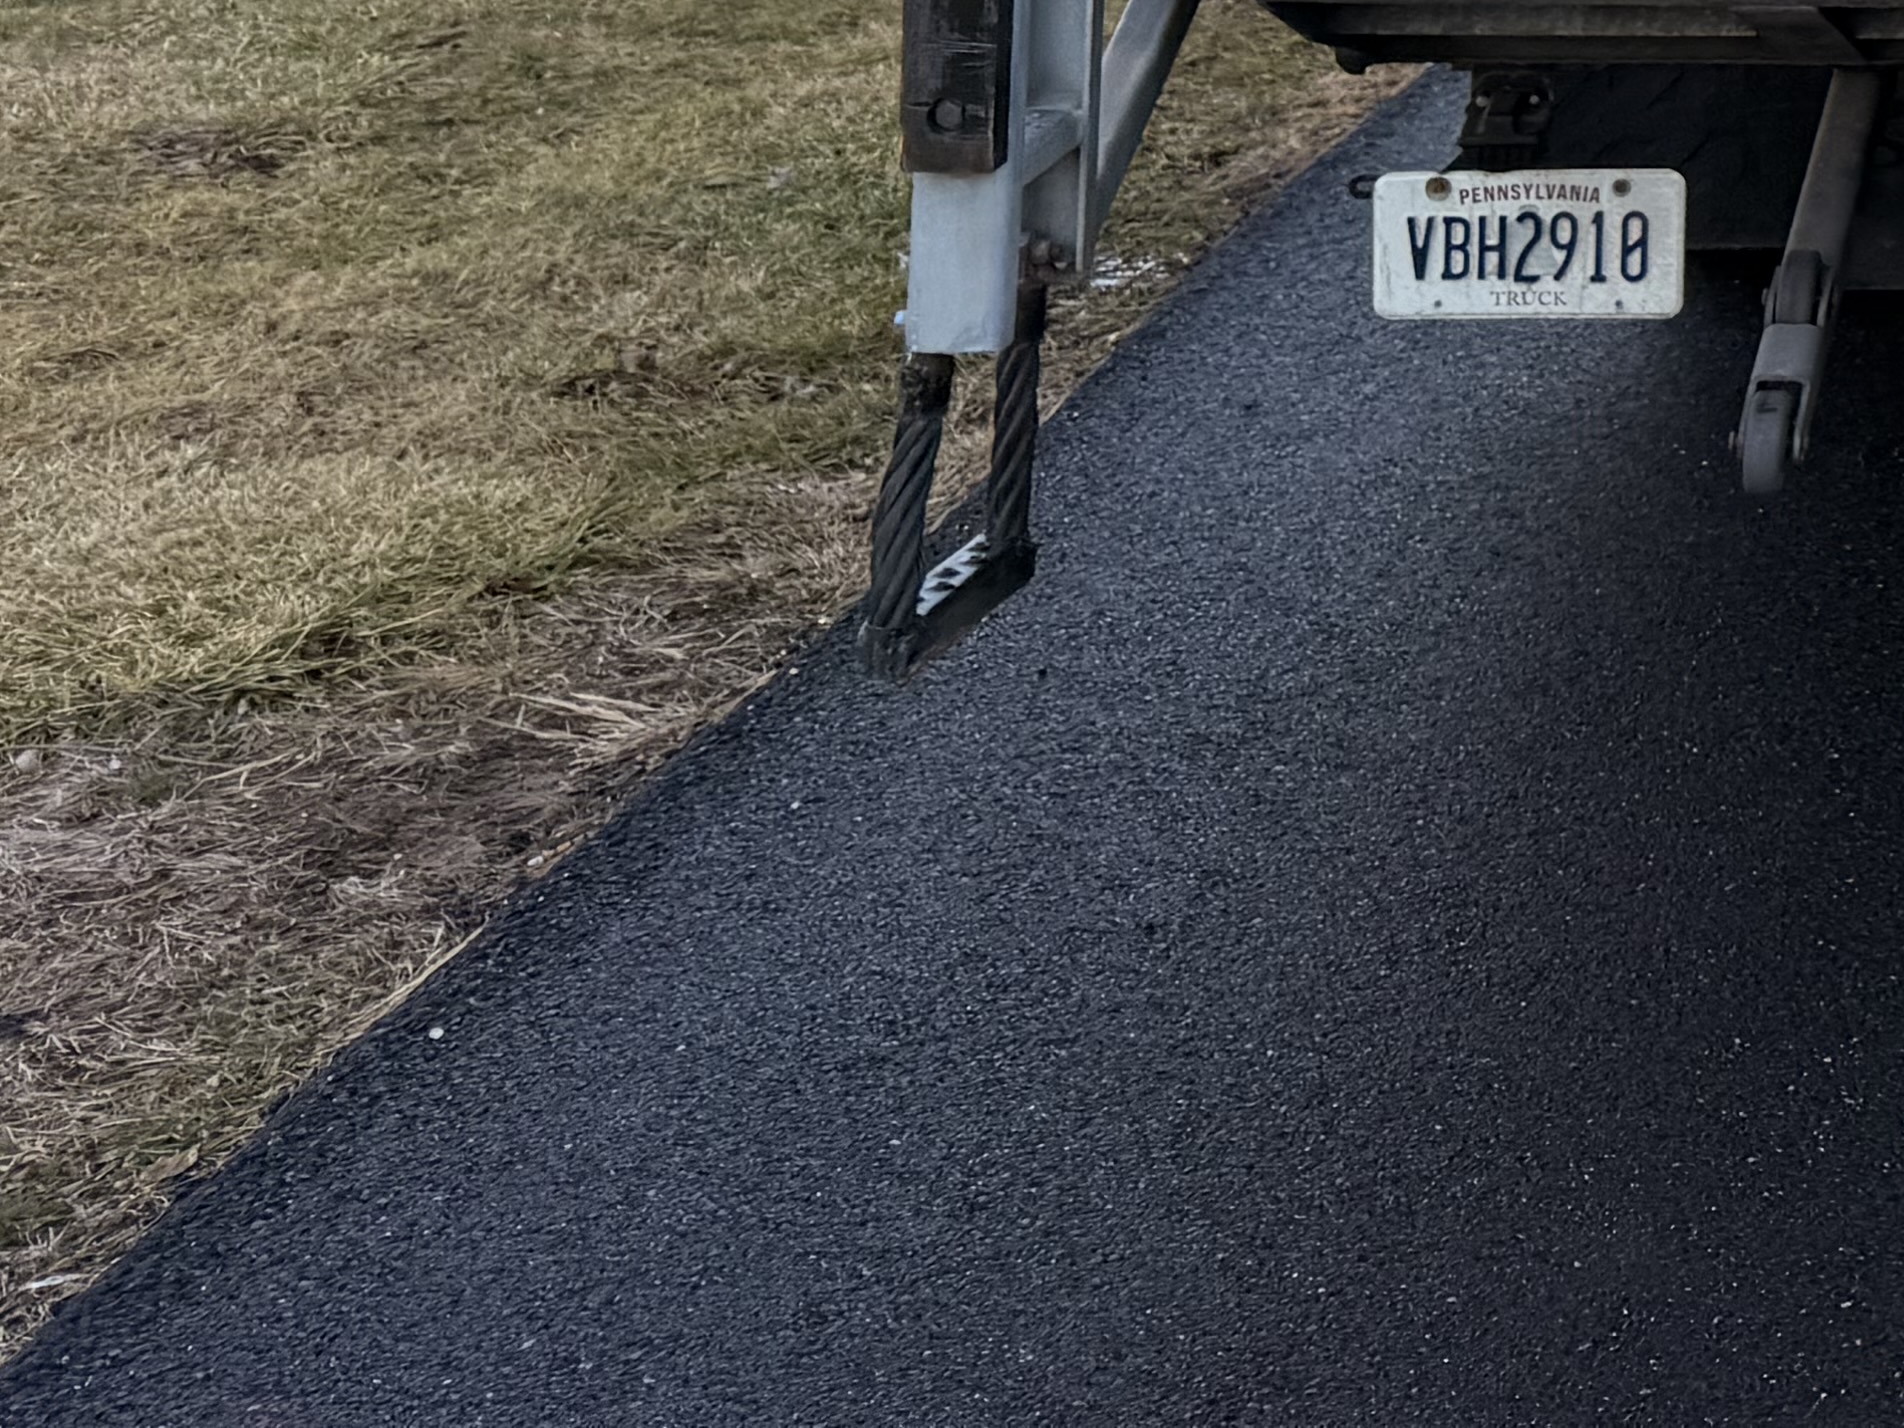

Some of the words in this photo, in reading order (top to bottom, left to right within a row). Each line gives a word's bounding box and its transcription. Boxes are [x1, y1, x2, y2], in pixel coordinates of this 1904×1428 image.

[1458, 182, 1601, 206] PENNSYLVANIA
[1406, 210, 1650, 285] VBH2910
[1490, 290, 1568, 307] TRUCK
